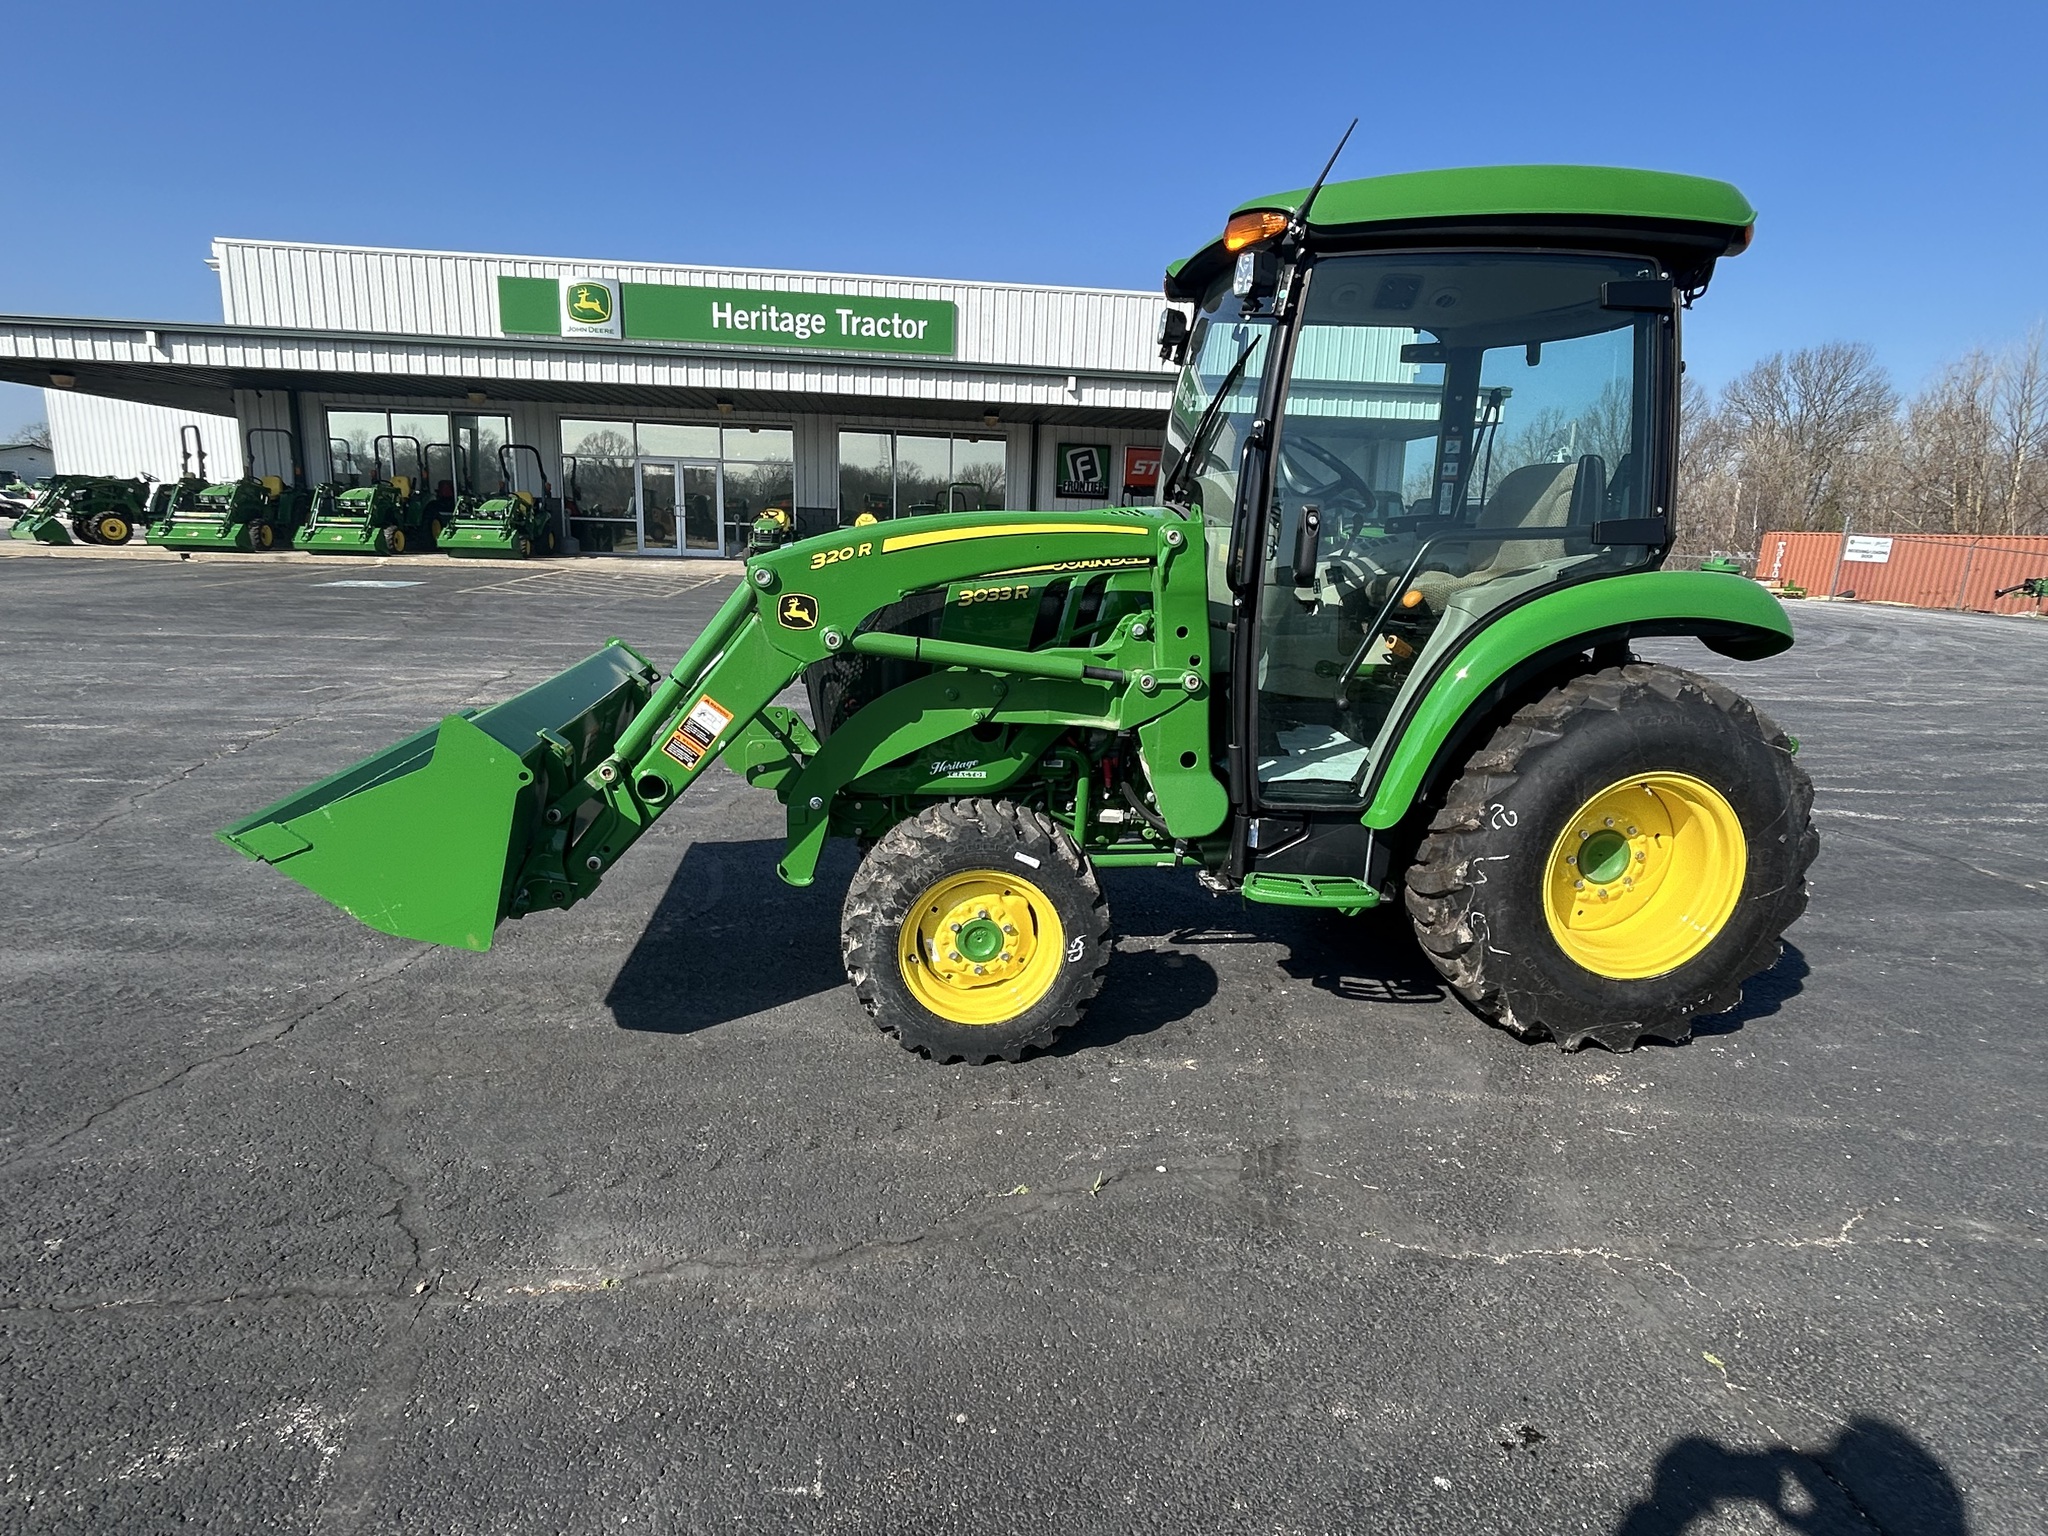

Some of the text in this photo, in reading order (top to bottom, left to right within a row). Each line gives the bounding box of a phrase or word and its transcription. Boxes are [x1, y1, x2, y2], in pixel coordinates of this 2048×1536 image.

[711, 301, 928, 340] Heritage Tractor
[567, 325, 615, 335] JOHN DEERE
[1131, 460, 1160, 475] ST
[1063, 480, 1104, 494] FRONTIER
[810, 542, 873, 570] 320 R
[957, 584, 1032, 607] 3033 R
[930, 760, 979, 775] Heritage
